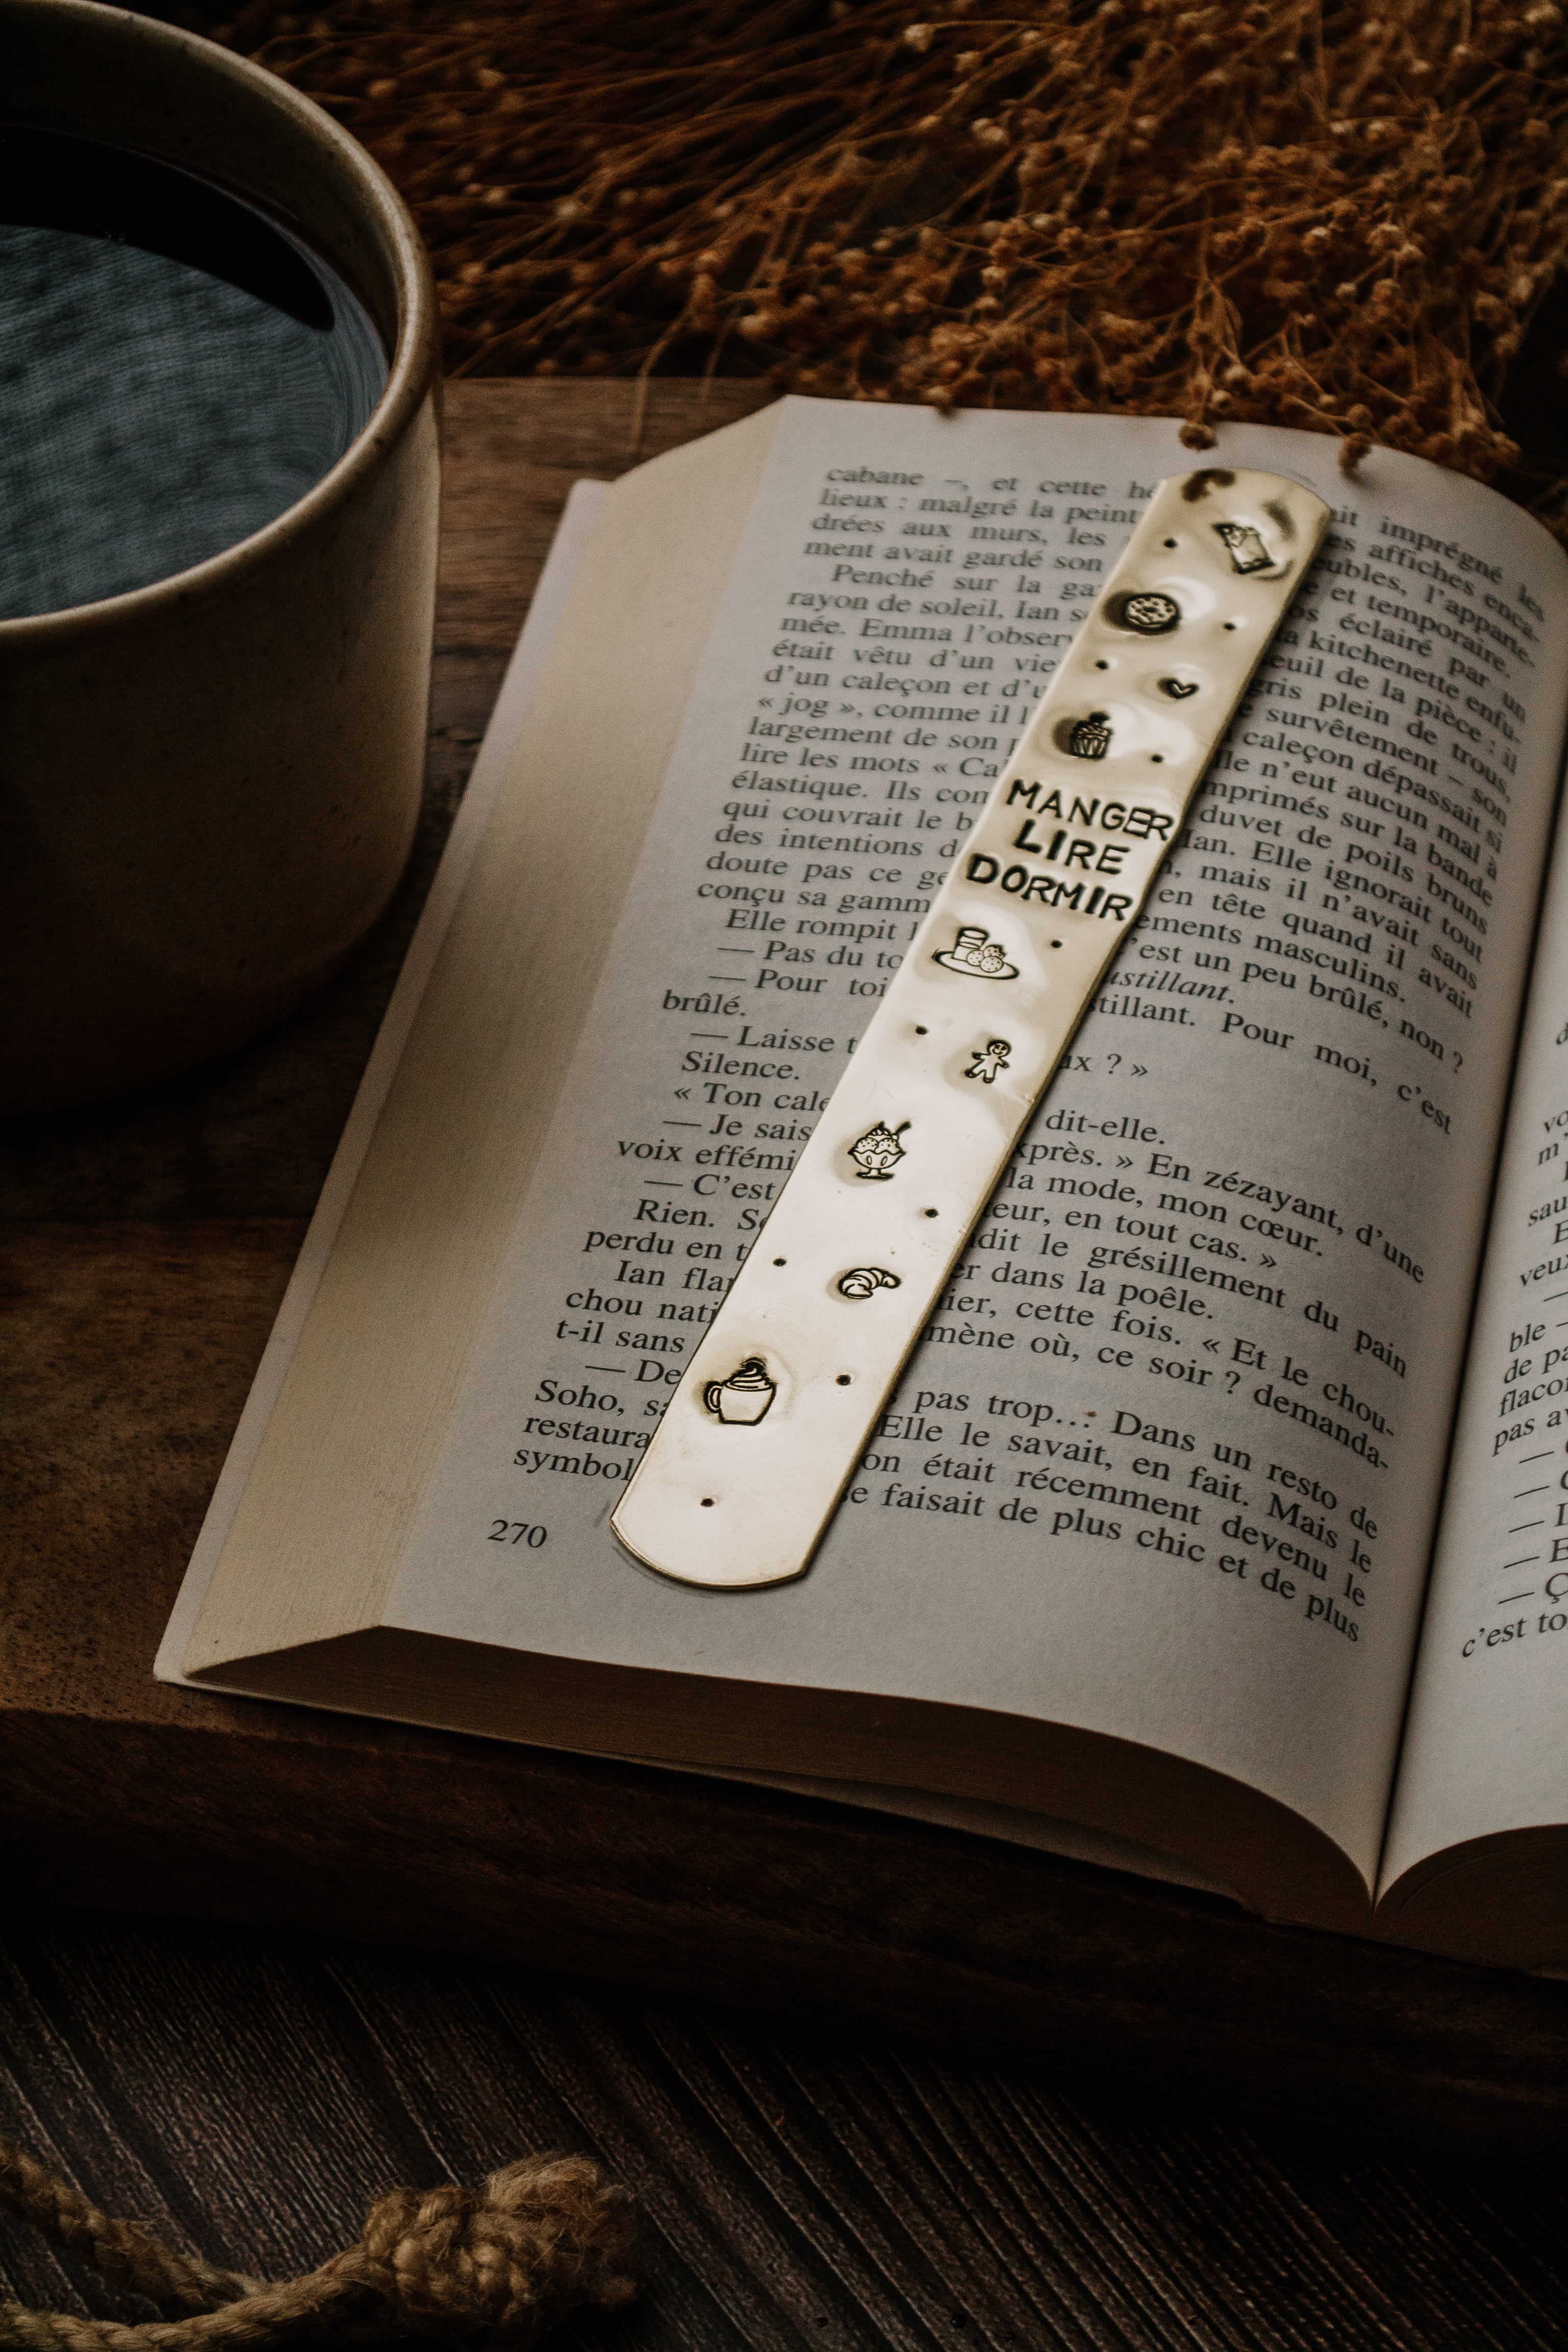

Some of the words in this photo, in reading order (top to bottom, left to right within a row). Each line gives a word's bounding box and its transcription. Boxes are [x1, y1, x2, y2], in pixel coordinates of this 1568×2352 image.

[826, 467, 923, 486] cabane
[918, 497, 1017, 520] malgré
[804, 543, 874, 558] ment
[884, 547, 953, 564] avait
[962, 550, 1043, 570] gardé
[1054, 557, 1102, 573] son
[788, 593, 868, 612] rayon
[1309, 630, 1460, 699] kitchenette
[831, 564, 934, 588] Penché
[953, 578, 997, 591] sur
[1338, 613, 1432, 659] éclairé
[764, 665, 829, 687] d’un
[841, 672, 950, 697] caleçon
[962, 681, 990, 696] et
[1266, 709, 1439, 776] survêtement
[772, 640, 834, 660] était
[853, 646, 911, 666] vêtu
[928, 649, 994, 670] d’un
[1317, 692, 1390, 727] plein
[859, 618, 952, 642] Emma
[1334, 667, 1369, 691] de
[1414, 695, 1482, 742] pièce
[748, 716, 893, 745] largement
[903, 727, 938, 747] de
[948, 736, 997, 750] son
[1260, 761, 1337, 794] n’eut
[1345, 786, 1428, 831] aucun
[778, 694, 829, 719] jog
[873, 704, 980, 722] comme
[1243, 729, 1355, 770] caleçon
[1363, 758, 1480, 833] dépassait
[1006, 778, 1174, 841] MANGER
[731, 770, 867, 801] élastique.
[886, 780, 920, 801] Ils
[1200, 804, 1283, 837] duvet
[1296, 825, 1332, 850] de
[1343, 843, 1414, 883] poils
[1426, 872, 1487, 935] bruns
[740, 743, 789, 765] lire
[798, 747, 838, 768] les
[849, 757, 919, 773] mots
[1339, 812, 1385, 839] sur
[1427, 843, 1493, 906] bande
[1013, 818, 1131, 875] LIRE
[715, 824, 764, 846] des
[778, 834, 923, 856] intentions
[1199, 866, 1270, 892] mais
[1285, 878, 1307, 902] il
[1320, 894, 1419, 948] n’avait
[1429, 943, 1477, 990] sans
[723, 799, 770, 820] qui
[782, 807, 903, 828] couvrait
[915, 810, 942, 830] le
[1251, 840, 1312, 873] Elle
[1324, 860, 1433, 924] ignorait
[1440, 917, 1483, 964] tout
[966, 852, 1133, 921] DORMIR
[696, 884, 785, 908] conçu
[797, 892, 827, 908] sa
[1253, 935, 1406, 1003] masculins.
[705, 851, 789, 876] doute
[801, 864, 853, 884] pas
[868, 868, 902, 883] ce
[1158, 886, 1193, 907] en
[1211, 893, 1266, 920] tête
[1281, 913, 1373, 955] quand
[1385, 943, 1406, 971] il
[1417, 967, 1473, 1019] avait
[725, 909, 786, 933] Elle
[795, 919, 897, 944] rompit
[1194, 952, 1231, 973] un
[1240, 962, 1296, 990] peu
[1308, 974, 1389, 1028] brûlé,
[1400, 1018, 1444, 1061] non
[763, 940, 815, 964] Pas
[826, 945, 864, 967] du
[662, 989, 746, 1017] brûlé.
[736, 1025, 835, 1054] Laisse
[754, 968, 828, 994] Pour
[1220, 1012, 1295, 1050] Pour
[1314, 1045, 1377, 1088] moi,
[1396, 1084, 1452, 1136] c’est
[681, 1050, 799, 1081] Silence.
[703, 1082, 762, 1108] Ton
[1045, 1109, 1166, 1145] dit-elle.
[618, 1138, 683, 1163] voix
[1046, 1177, 1143, 1208] mode,
[1157, 1193, 1228, 1224] mon
[1239, 1214, 1324, 1257] cœur.
[694, 1173, 776, 1201] C’est
[1064, 1211, 1101, 1230] en
[1115, 1215, 1179, 1243] tout
[1189, 1233, 1247, 1262] cas.
[708, 1114, 743, 1137] Je
[754, 1119, 812, 1141] sais
[1146, 1153, 1191, 1182] En
[1203, 1171, 1344, 1236] zézayant,
[1355, 1224, 1424, 1284] d’une
[582, 1231, 675, 1256] perdu
[685, 1242, 723, 1260] en
[991, 1261, 1064, 1290] dans
[1076, 1270, 1106, 1296] la
[1116, 1284, 1214, 1320] poêle.
[633, 1198, 715, 1228] Rien.
[1039, 1233, 1069, 1258] le
[1087, 1246, 1286, 1309] grésillement
[1303, 1300, 1339, 1333] du
[1353, 1329, 1407, 1379] pain
[556, 1319, 605, 1344] t-il
[615, 1331, 685, 1353] sans
[565, 1288, 643, 1316] chou
[1030, 1333, 1080, 1362] où,
[1096, 1347, 1134, 1367] ce
[1148, 1357, 1213, 1387] soir
[1252, 1384, 1388, 1469] demanda-
[614, 1260, 665, 1287] Ian
[1015, 1302, 1094, 1327] cette
[1110, 1309, 1181, 1345] fois.
[1230, 1337, 1267, 1370] Et
[1280, 1356, 1309, 1387] le
[1322, 1383, 1394, 1437] chou-
[1503, 1358, 1532, 1384] de
[1509, 1323, 1546, 1353] ble
[534, 1379, 625, 1416] Soho,
[876, 1414, 943, 1442] Elle
[960, 1422, 990, 1448] le
[1007, 1435, 1113, 1472] savait,
[1131, 1457, 1170, 1482] en
[1187, 1465, 1249, 1507] fait.
[1265, 1492, 1338, 1550] Mais
[1348, 1538, 1372, 1574] le
[912, 1391, 970, 1414] pas
[1110, 1410, 1195, 1452] Dans
[1212, 1442, 1252, 1472] un
[1266, 1463, 1339, 1510] resto
[1348, 1506, 1378, 1540] de
[1492, 1418, 1535, 1457] pas
[487, 1519, 548, 1549] 270
[881, 1483, 985, 1517] faisait
[998, 1497, 1038, 1525] de
[1049, 1508, 1122, 1540] plus
[1135, 1526, 1206, 1563] chic
[1216, 1555, 1249, 1580] et
[1259, 1567, 1296, 1600] de
[1304, 1594, 1359, 1643] plus
[922, 1453, 996, 1483] était
[1015, 1467, 1202, 1526] récemment
[1220, 1514, 1328, 1582] devenu
[1342, 1572, 1366, 1607] le
[1461, 1618, 1527, 1658] c’est
